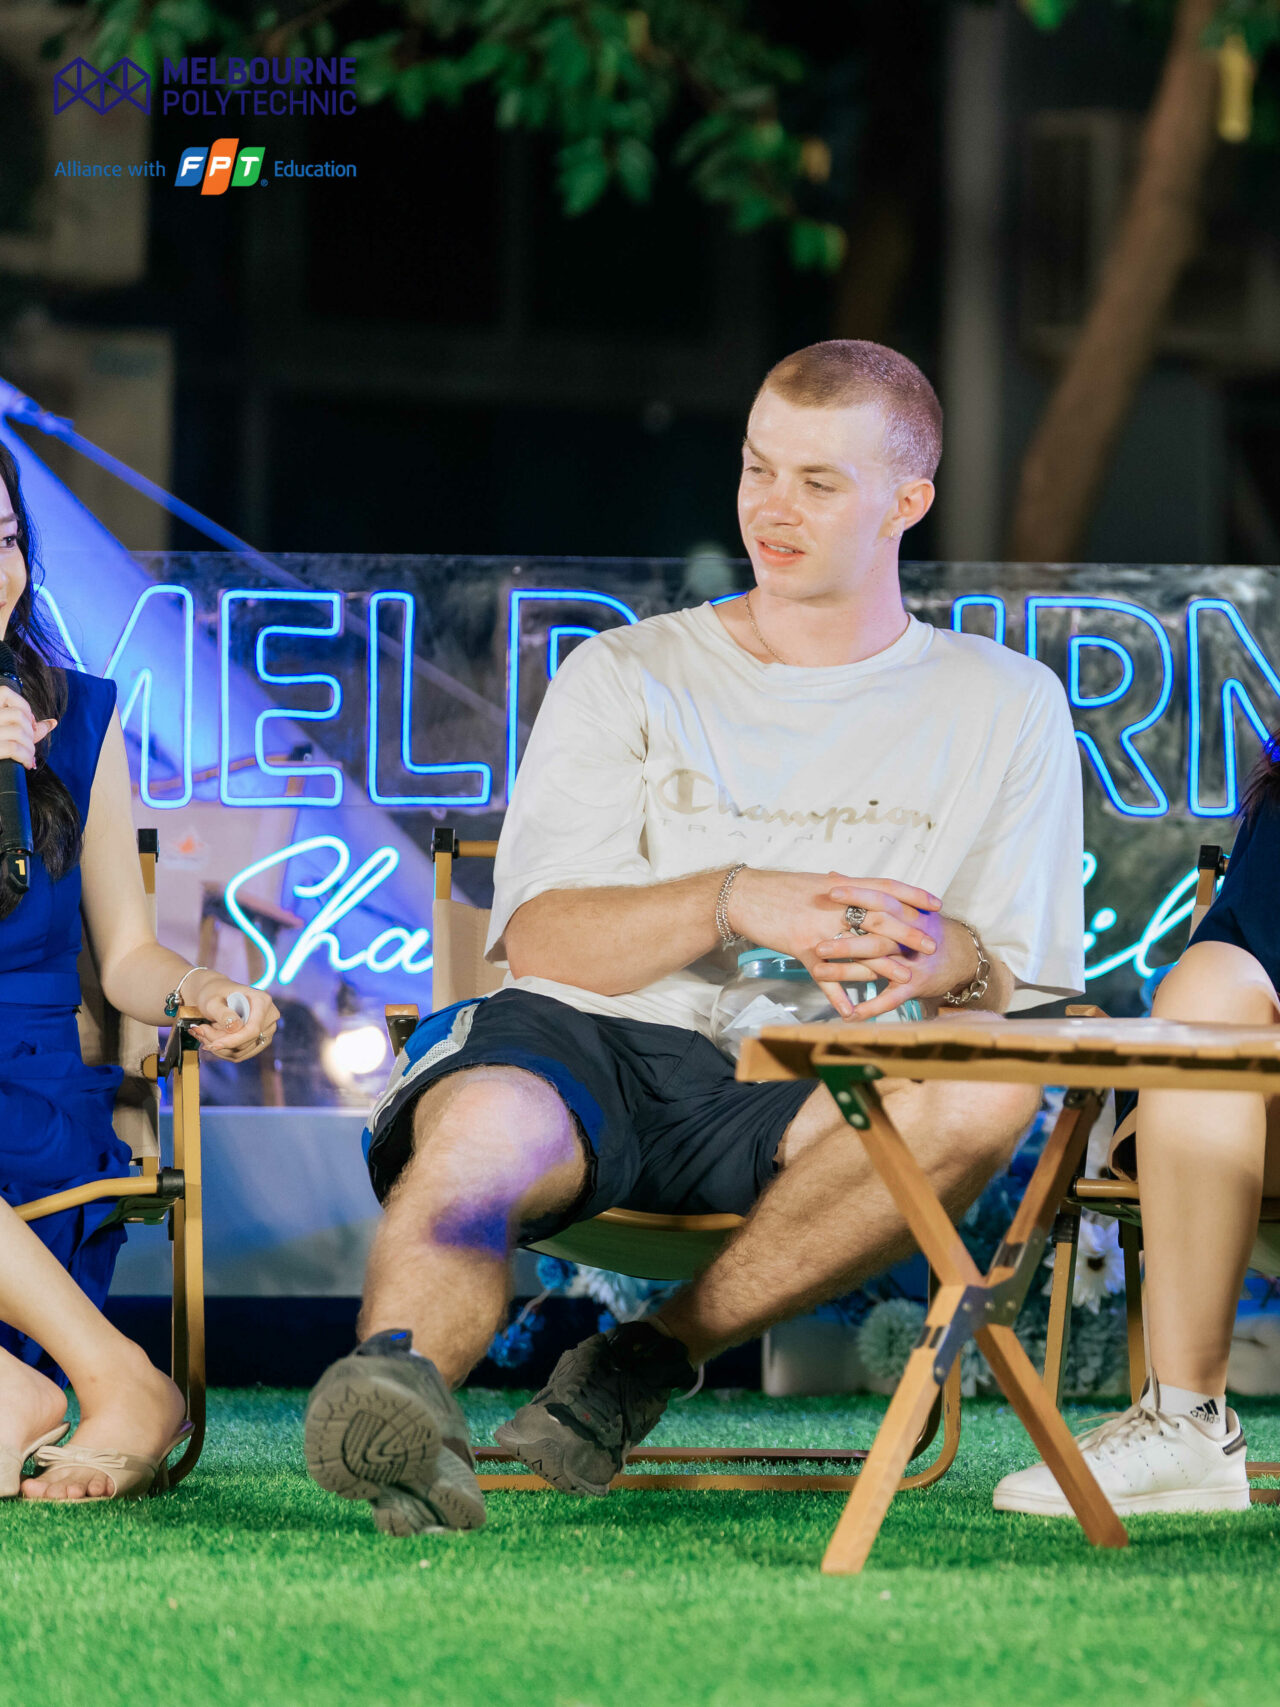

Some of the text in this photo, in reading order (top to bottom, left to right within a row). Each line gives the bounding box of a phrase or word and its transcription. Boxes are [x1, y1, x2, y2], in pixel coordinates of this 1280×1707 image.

[656, 768, 935, 843] Champion
[15, 859, 26, 876] 1
[224, 834, 433, 991] Sha
